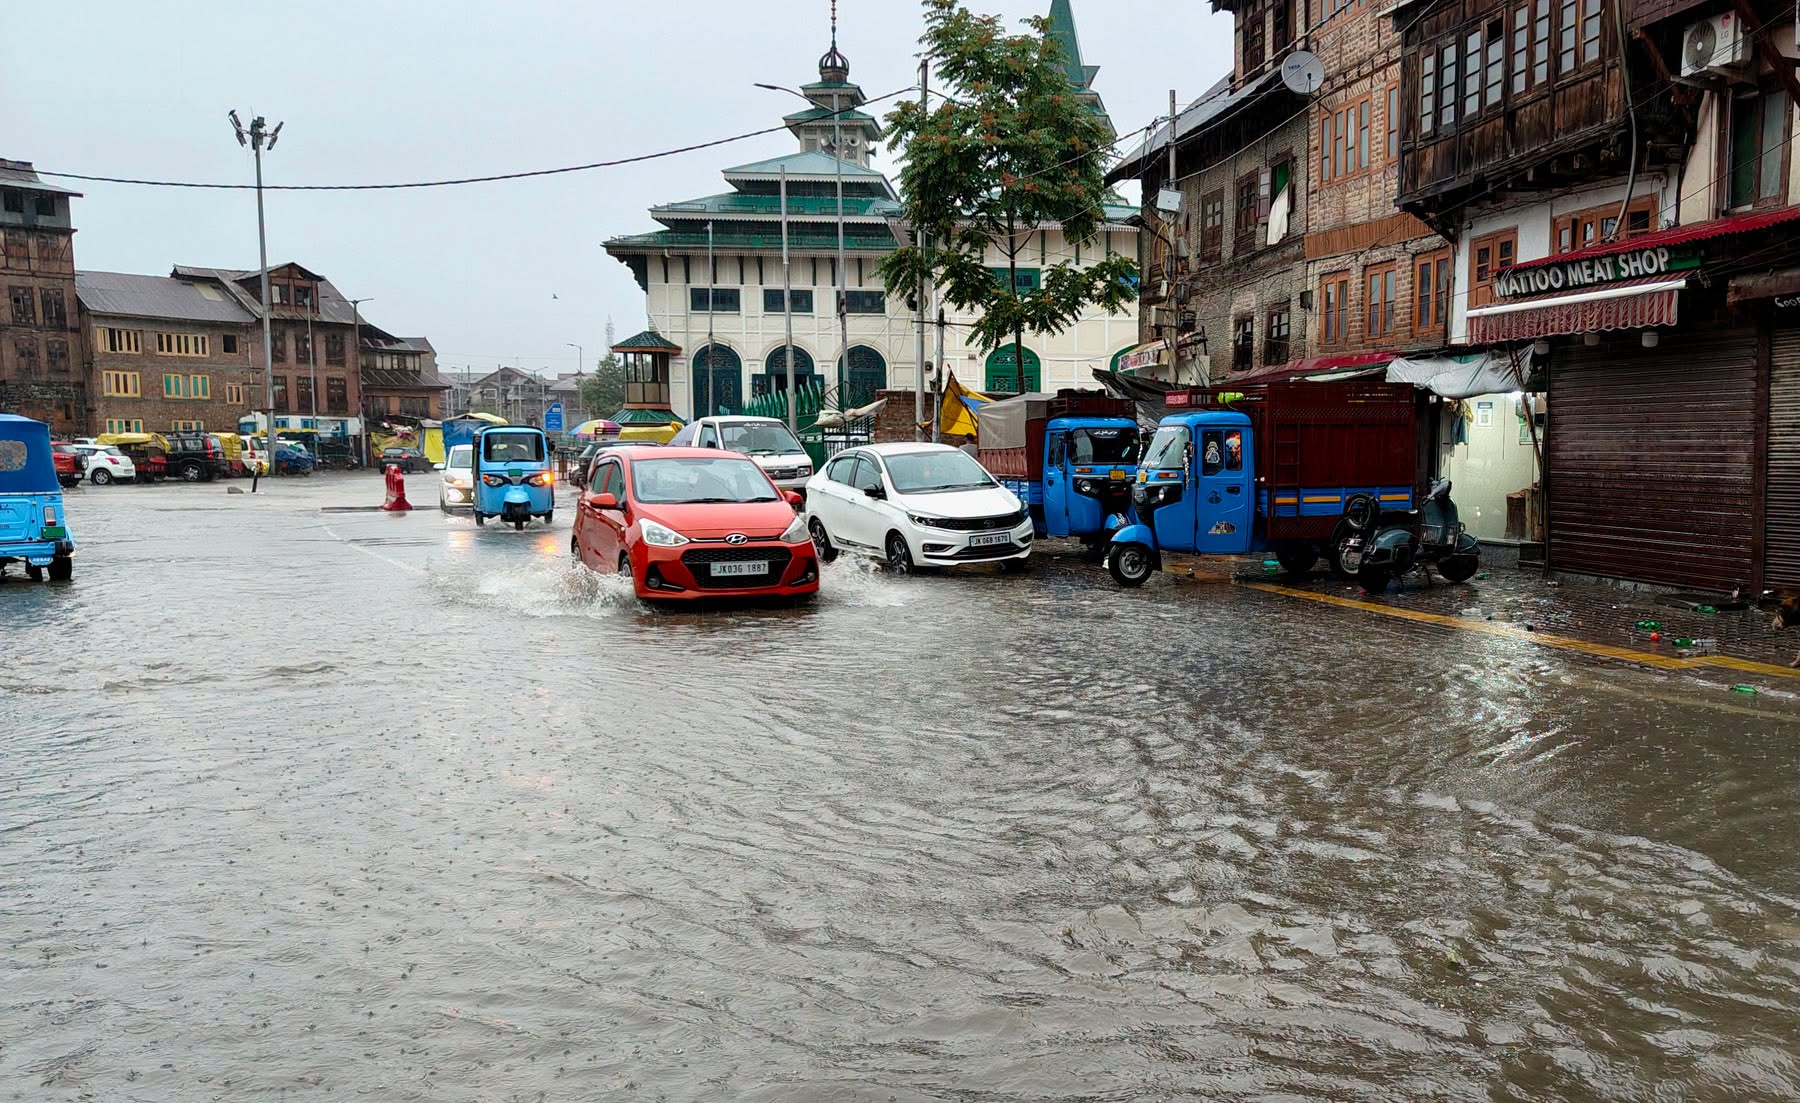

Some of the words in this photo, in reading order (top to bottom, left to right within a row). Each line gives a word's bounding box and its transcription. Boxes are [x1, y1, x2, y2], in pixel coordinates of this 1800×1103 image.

[1495, 266, 1564, 297] MATTOO
[1566, 257, 1616, 287] MEAT
[1618, 247, 1669, 279] SHOP
